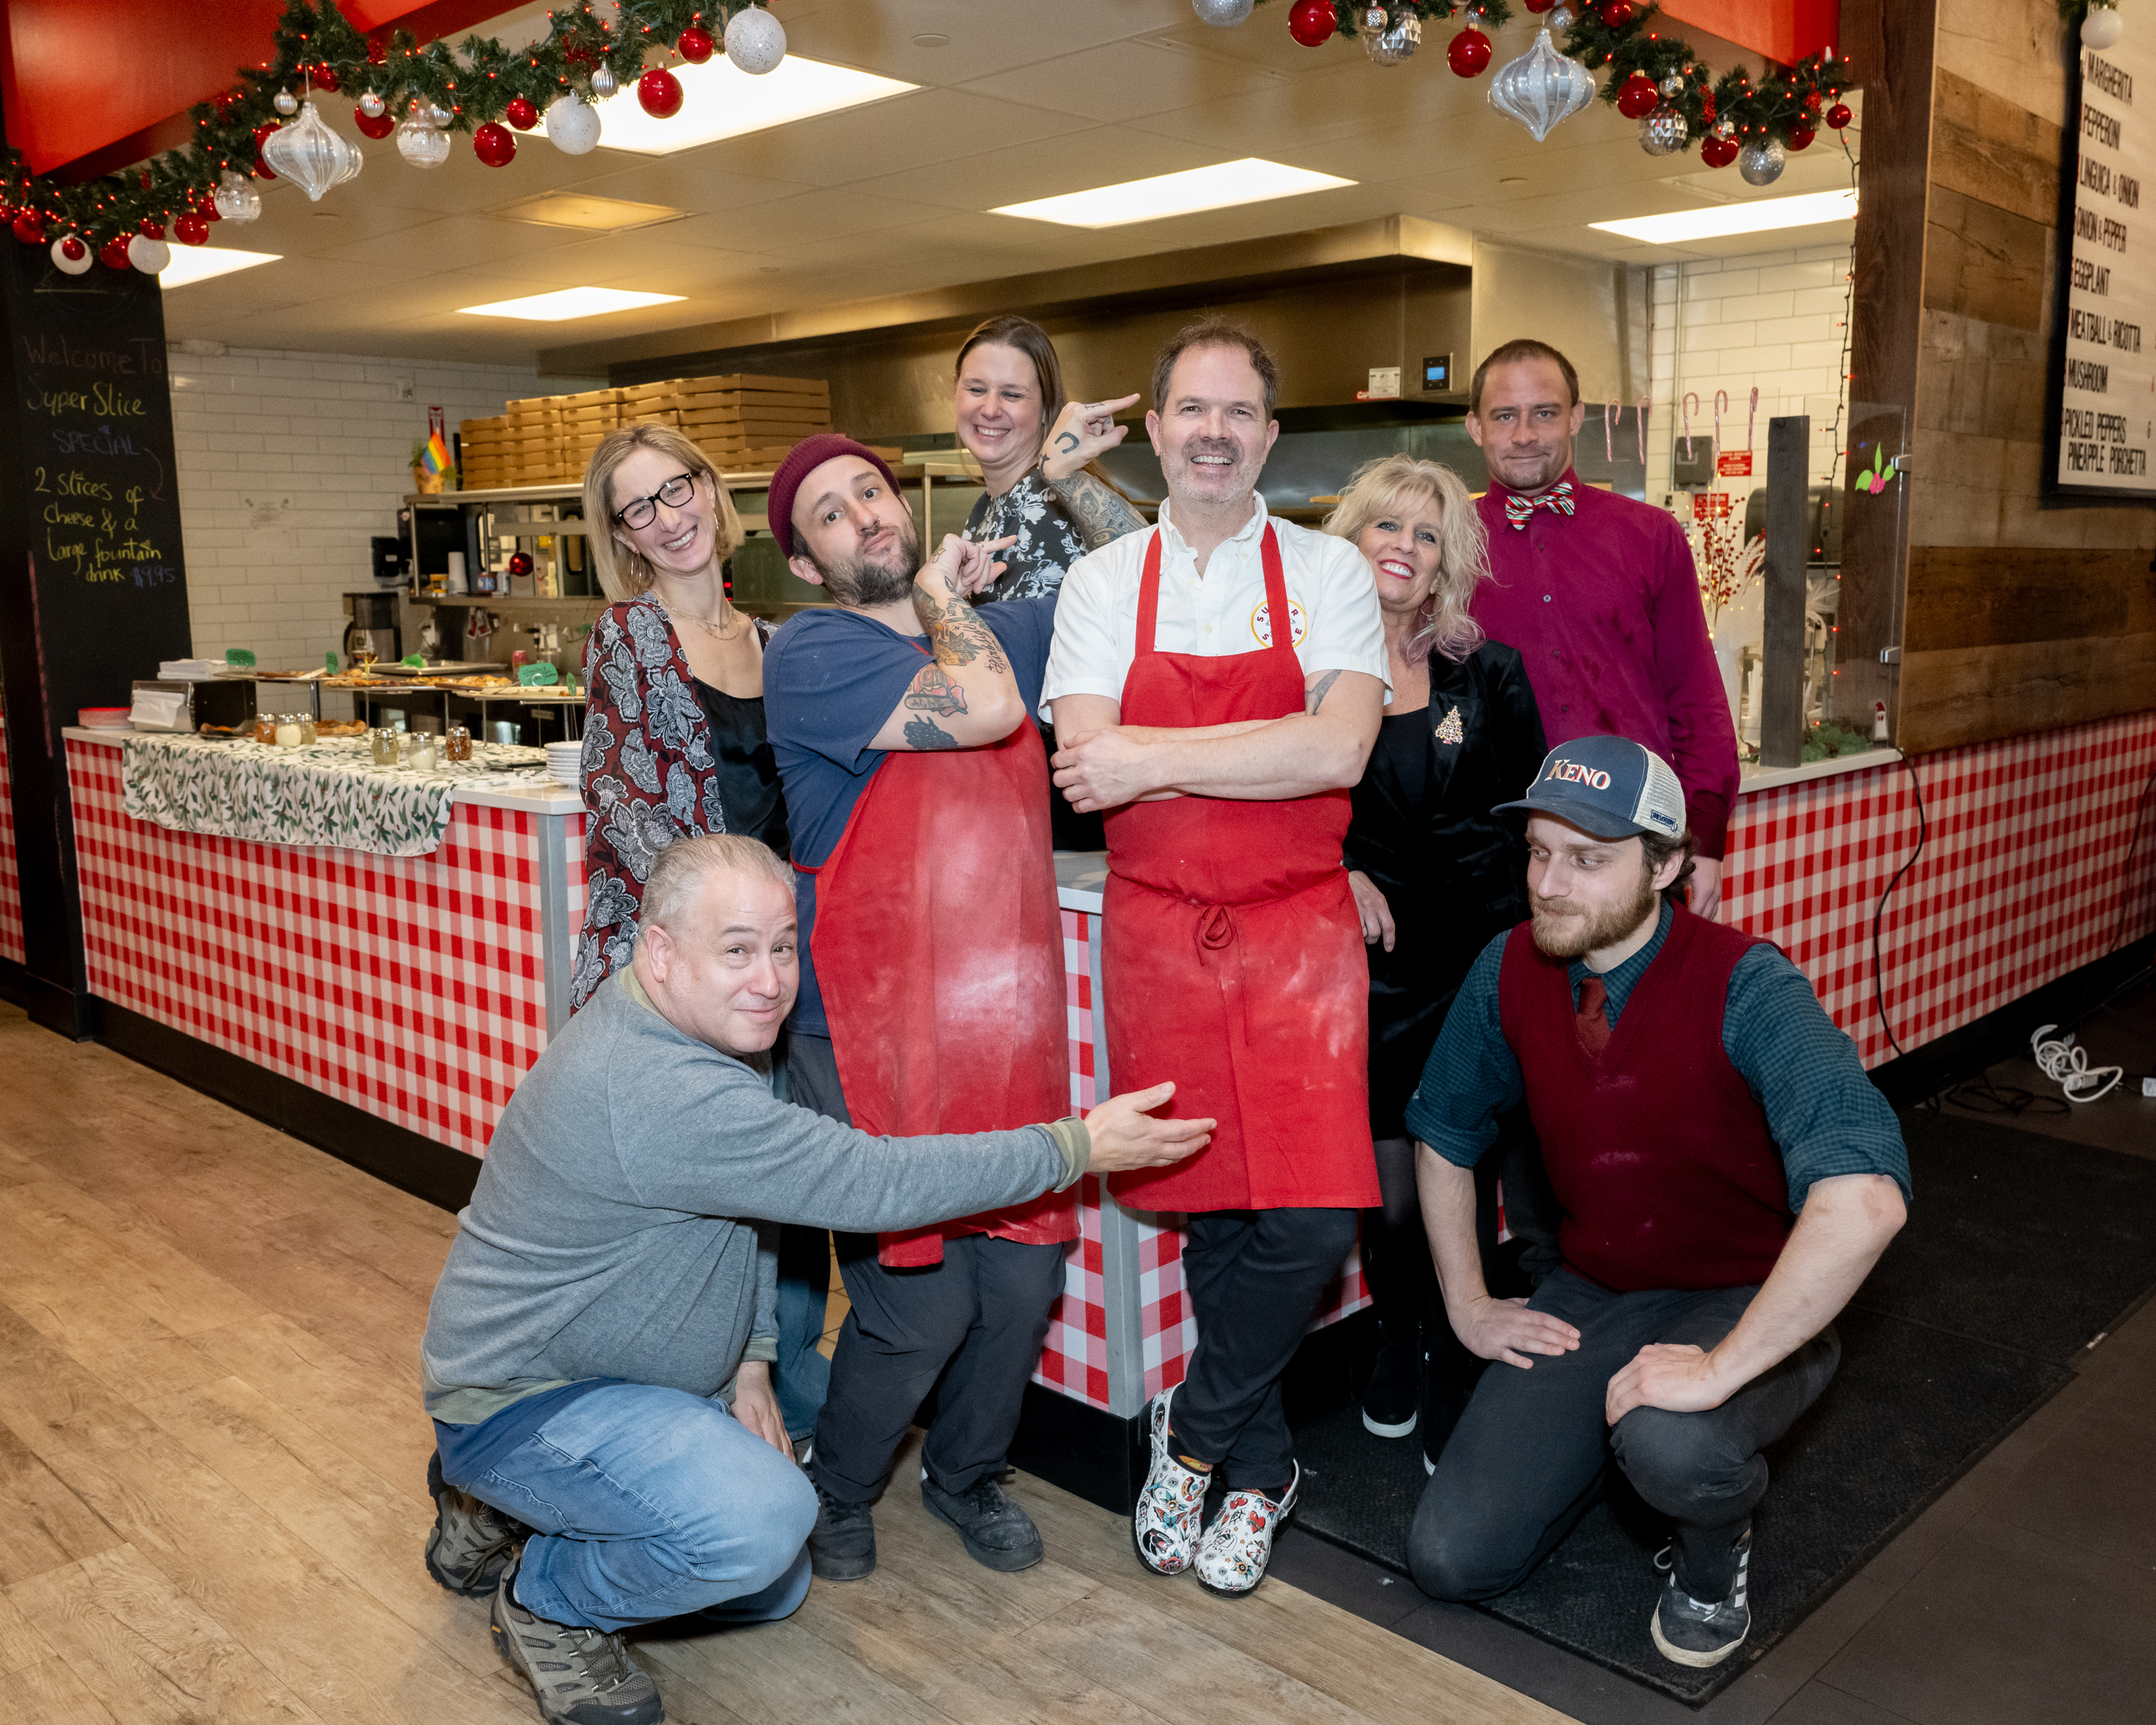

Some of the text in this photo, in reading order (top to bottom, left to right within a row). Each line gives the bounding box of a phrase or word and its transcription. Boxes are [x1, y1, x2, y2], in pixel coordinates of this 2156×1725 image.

[2086, 50, 2132, 106] MARGHERITA
[2083, 103, 2121, 151] PEPPERONI
[2118, 172, 2140, 209] ONION
[2076, 206, 2098, 243] ONION
[2074, 257, 2110, 296] EGGPLANT
[2070, 308, 2106, 346] MEATBALL
[2113, 318, 2141, 353] RICOTTA
[24, 334, 163, 374] Welcome To
[2067, 358, 2109, 393] MUSHROOM
[93, 382, 147, 416] Slice
[2064, 408, 2094, 440] PICKLED
[2096, 412, 2127, 444] PEPPERS
[2067, 441, 2147, 476] PINEAPPLE PORCHETTA
[35, 466, 51, 492] 2
[126, 485, 145, 515] of
[124, 518, 139, 531] a
[95, 538, 162, 569] fountain
[86, 563, 126, 583] drink
[1544, 758, 1611, 790] KENO
